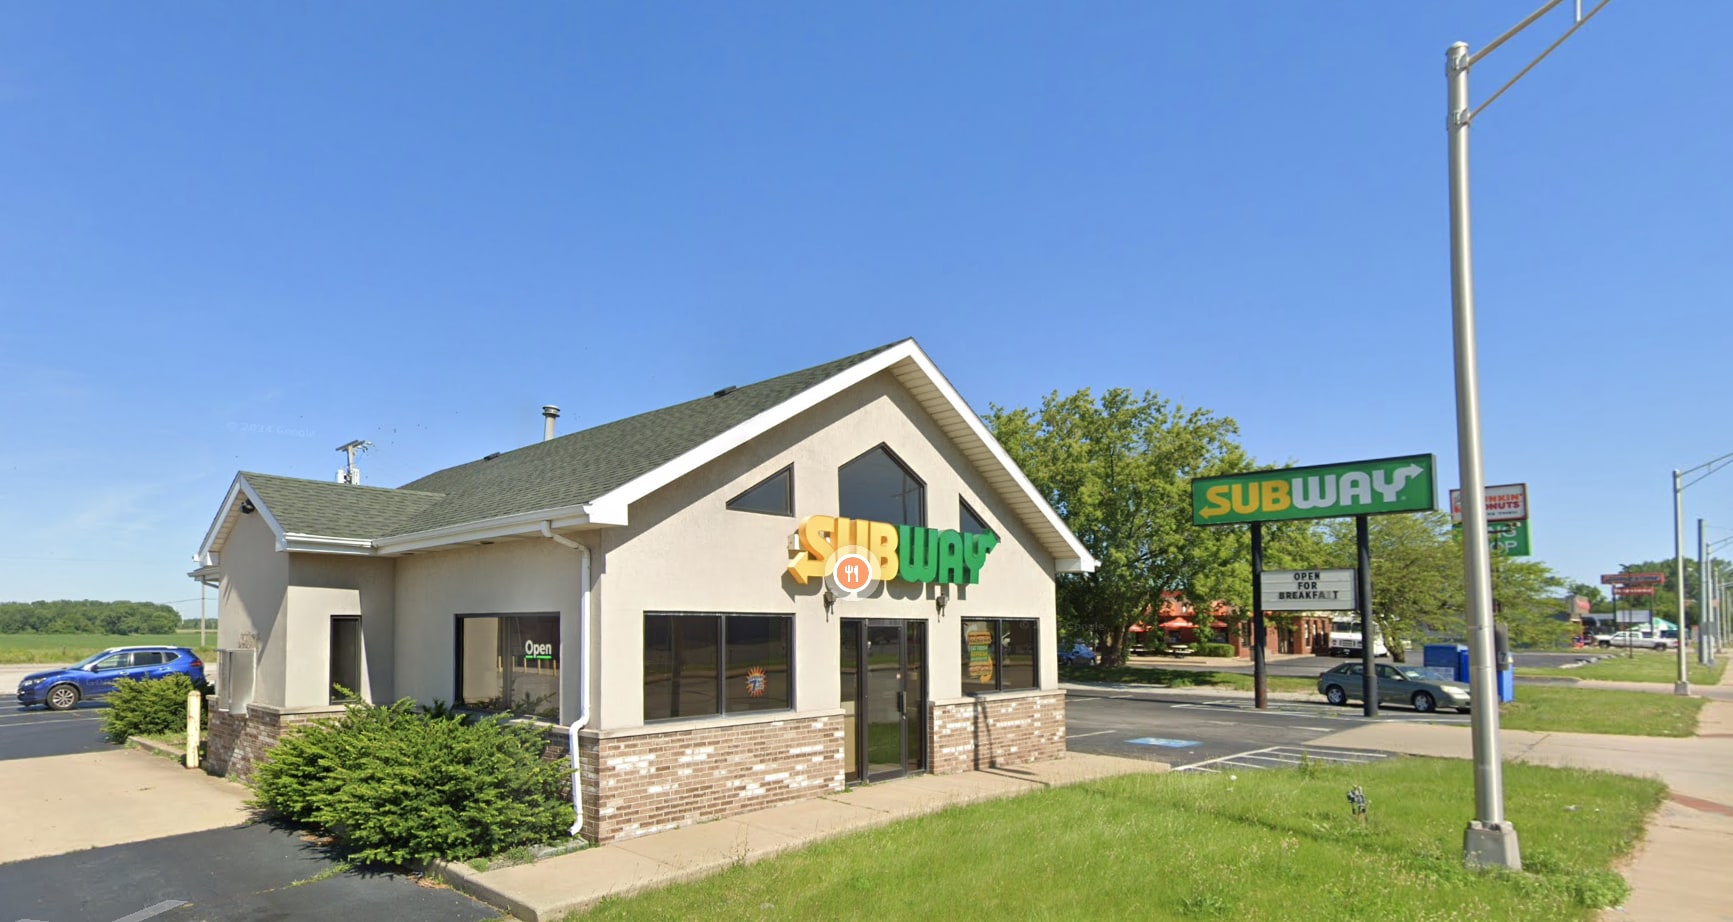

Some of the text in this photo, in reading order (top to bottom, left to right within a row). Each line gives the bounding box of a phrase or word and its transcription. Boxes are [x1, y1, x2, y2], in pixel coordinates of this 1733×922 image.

[1198, 462, 1424, 519] SUBWAY
[787, 515, 1000, 585] SUBWAY
[1293, 572, 1321, 581] OPEN
[1297, 582, 1318, 590] FOR
[525, 639, 551, 658] Open
